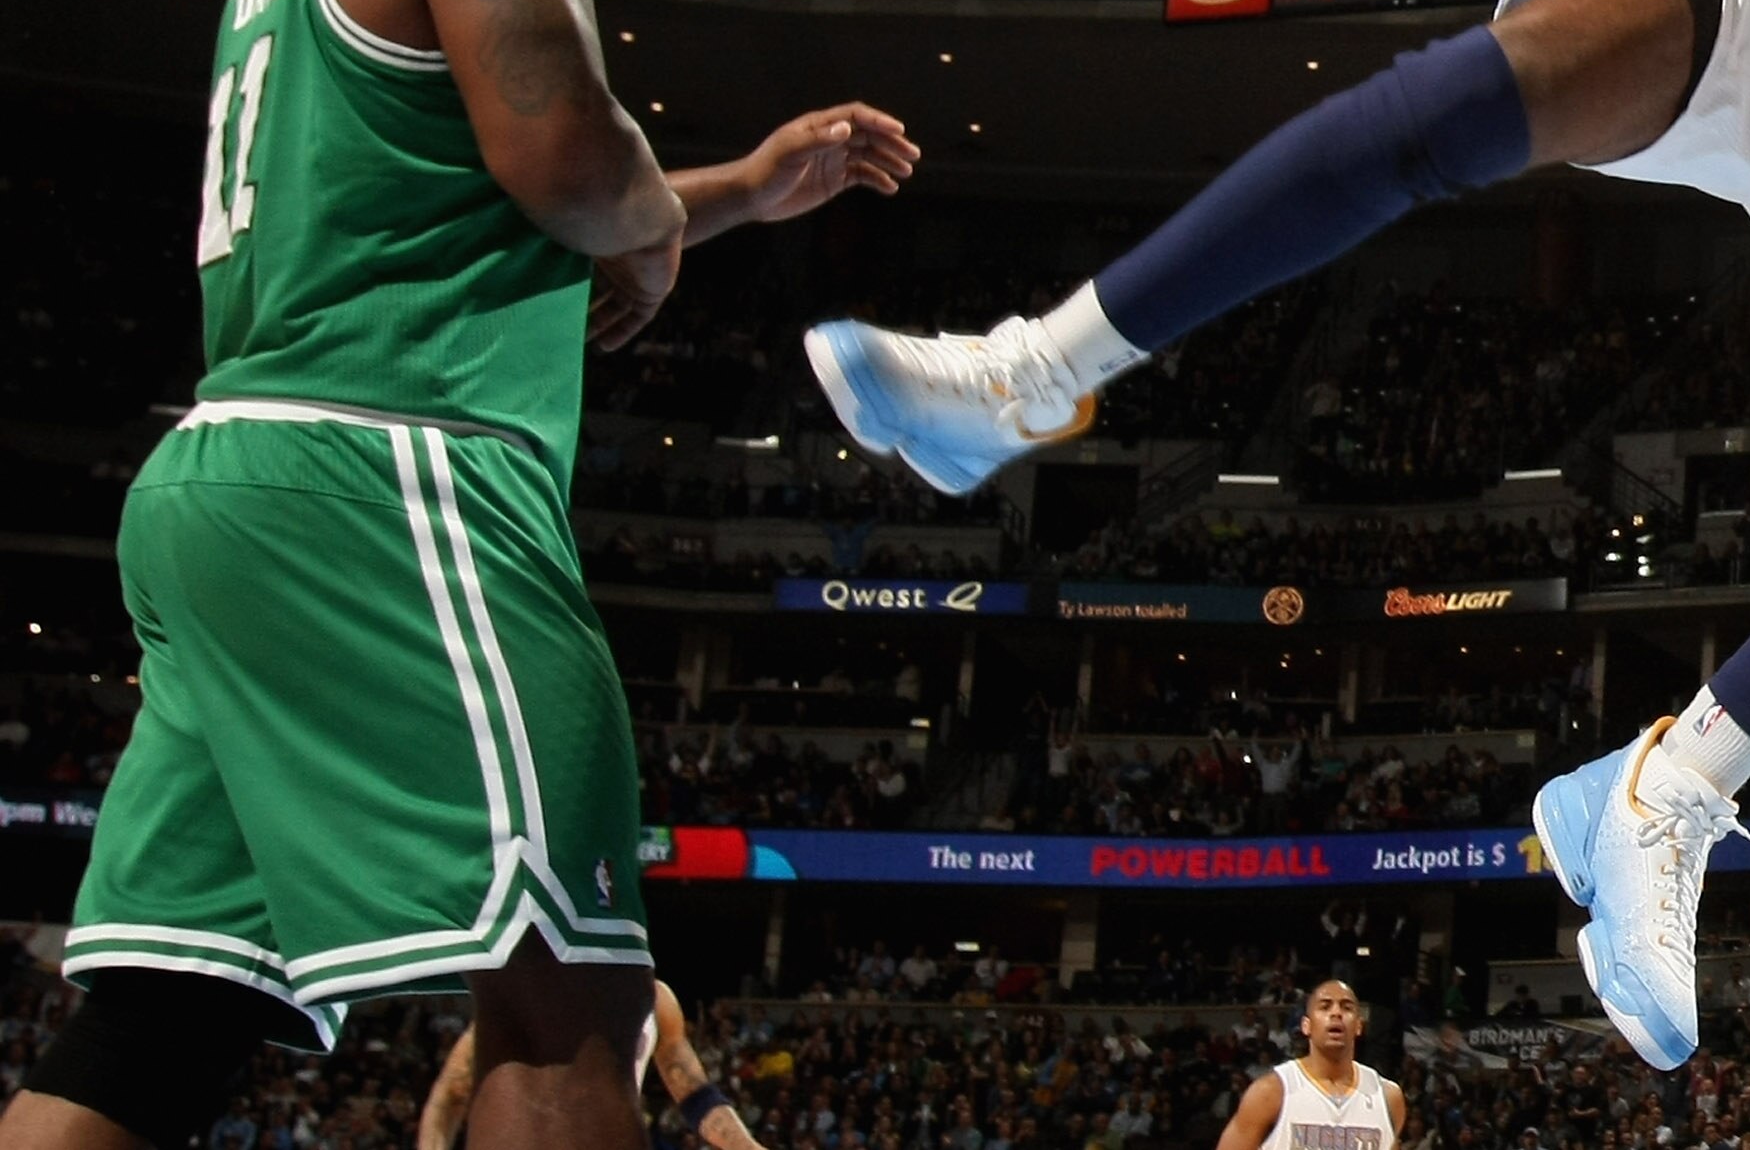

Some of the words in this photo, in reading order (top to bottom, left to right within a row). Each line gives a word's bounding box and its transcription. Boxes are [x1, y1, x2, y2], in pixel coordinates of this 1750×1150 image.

[197, 33, 274, 268] 11
[821, 578, 928, 612] Qwest
[1058, 599, 1074, 619] Ty
[1078, 601, 1132, 618] Lawson
[1384, 586, 1446, 616] Coors
[1446, 590, 1512, 611] LIGHT
[928, 845, 972, 869] The
[979, 848, 1035, 871] next
[1090, 844, 1331, 881] POWERBALL
[1372, 845, 1462, 875] Jackpot
[1466, 841, 1485, 867] is
[1491, 840, 1506, 869] $
[1468, 1027, 1566, 1046] BIRDMAN'S
